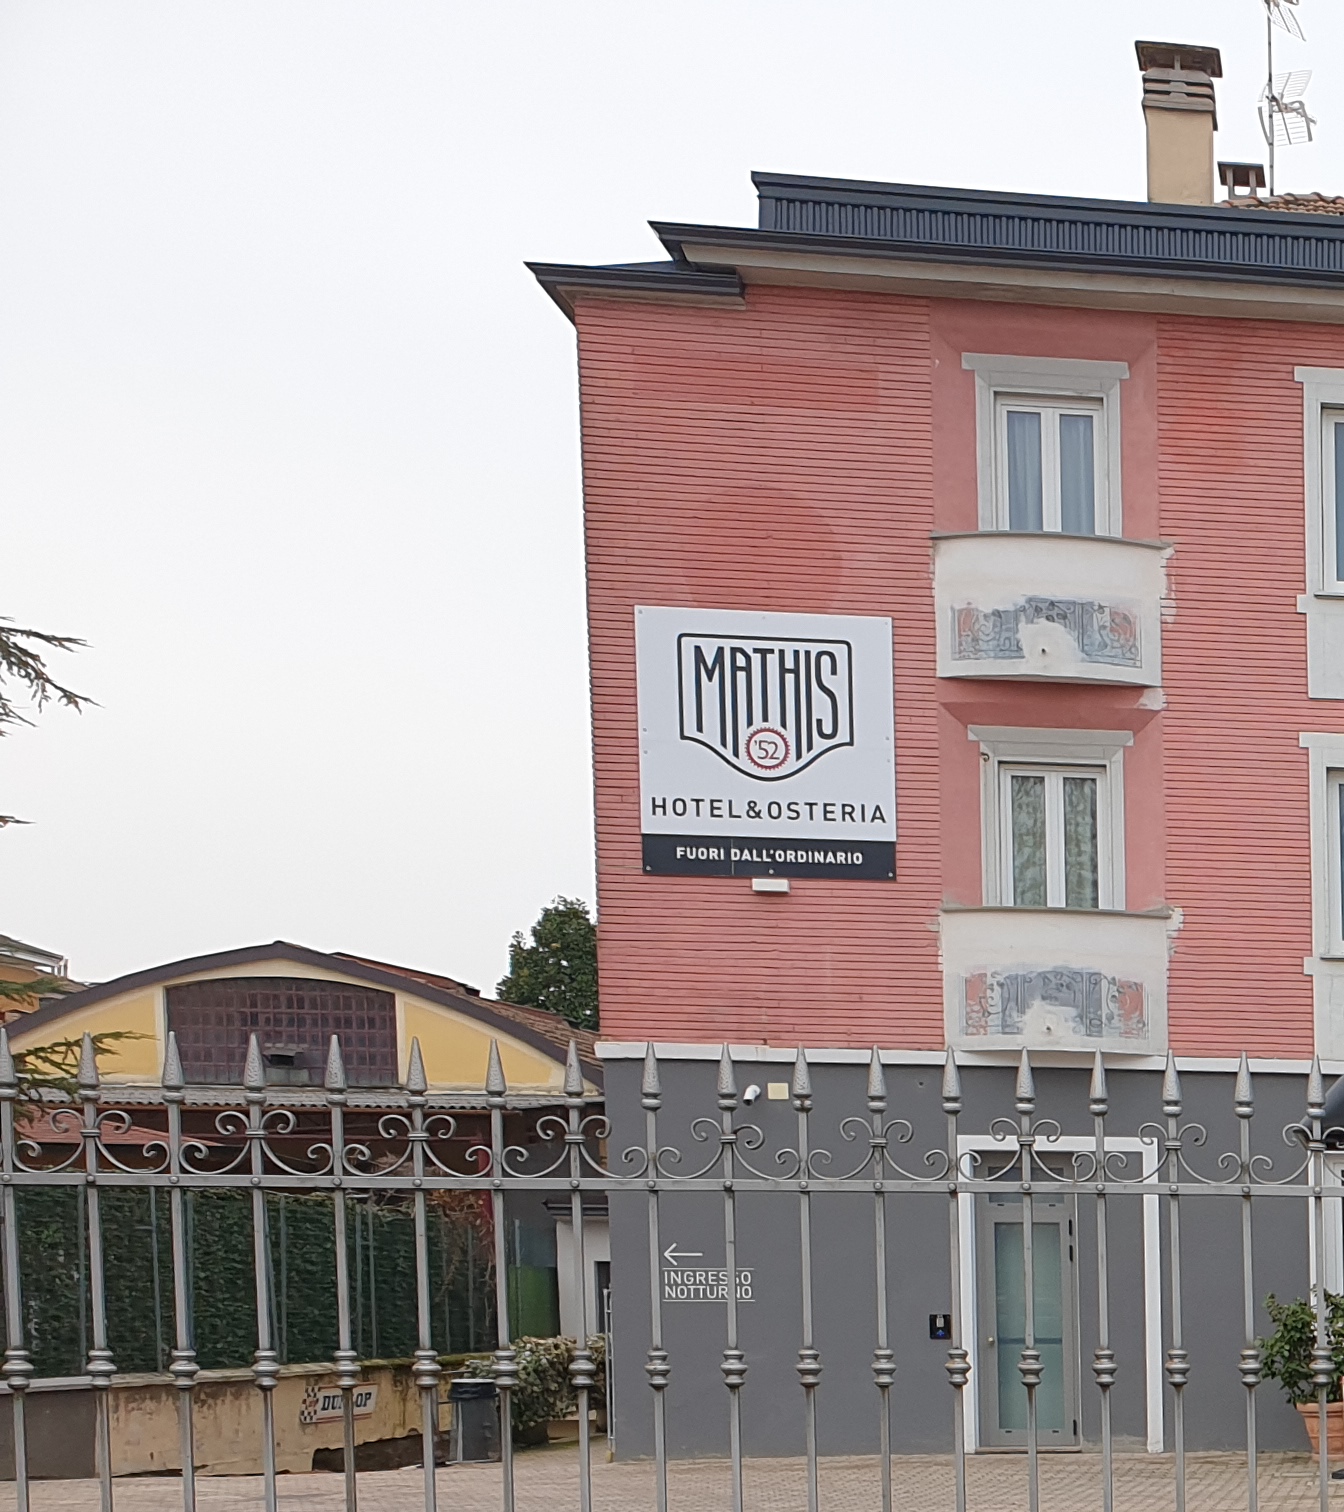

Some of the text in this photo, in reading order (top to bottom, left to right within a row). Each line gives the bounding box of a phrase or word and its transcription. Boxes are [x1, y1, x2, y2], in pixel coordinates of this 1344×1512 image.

[693, 644, 839, 762] MATHIS
[651, 796, 888, 825] HOTEL&OSTERIA
[676, 846, 864, 865] FUORI DALL'ORDINARIO
[320, 1392, 373, 1411] DUOP
